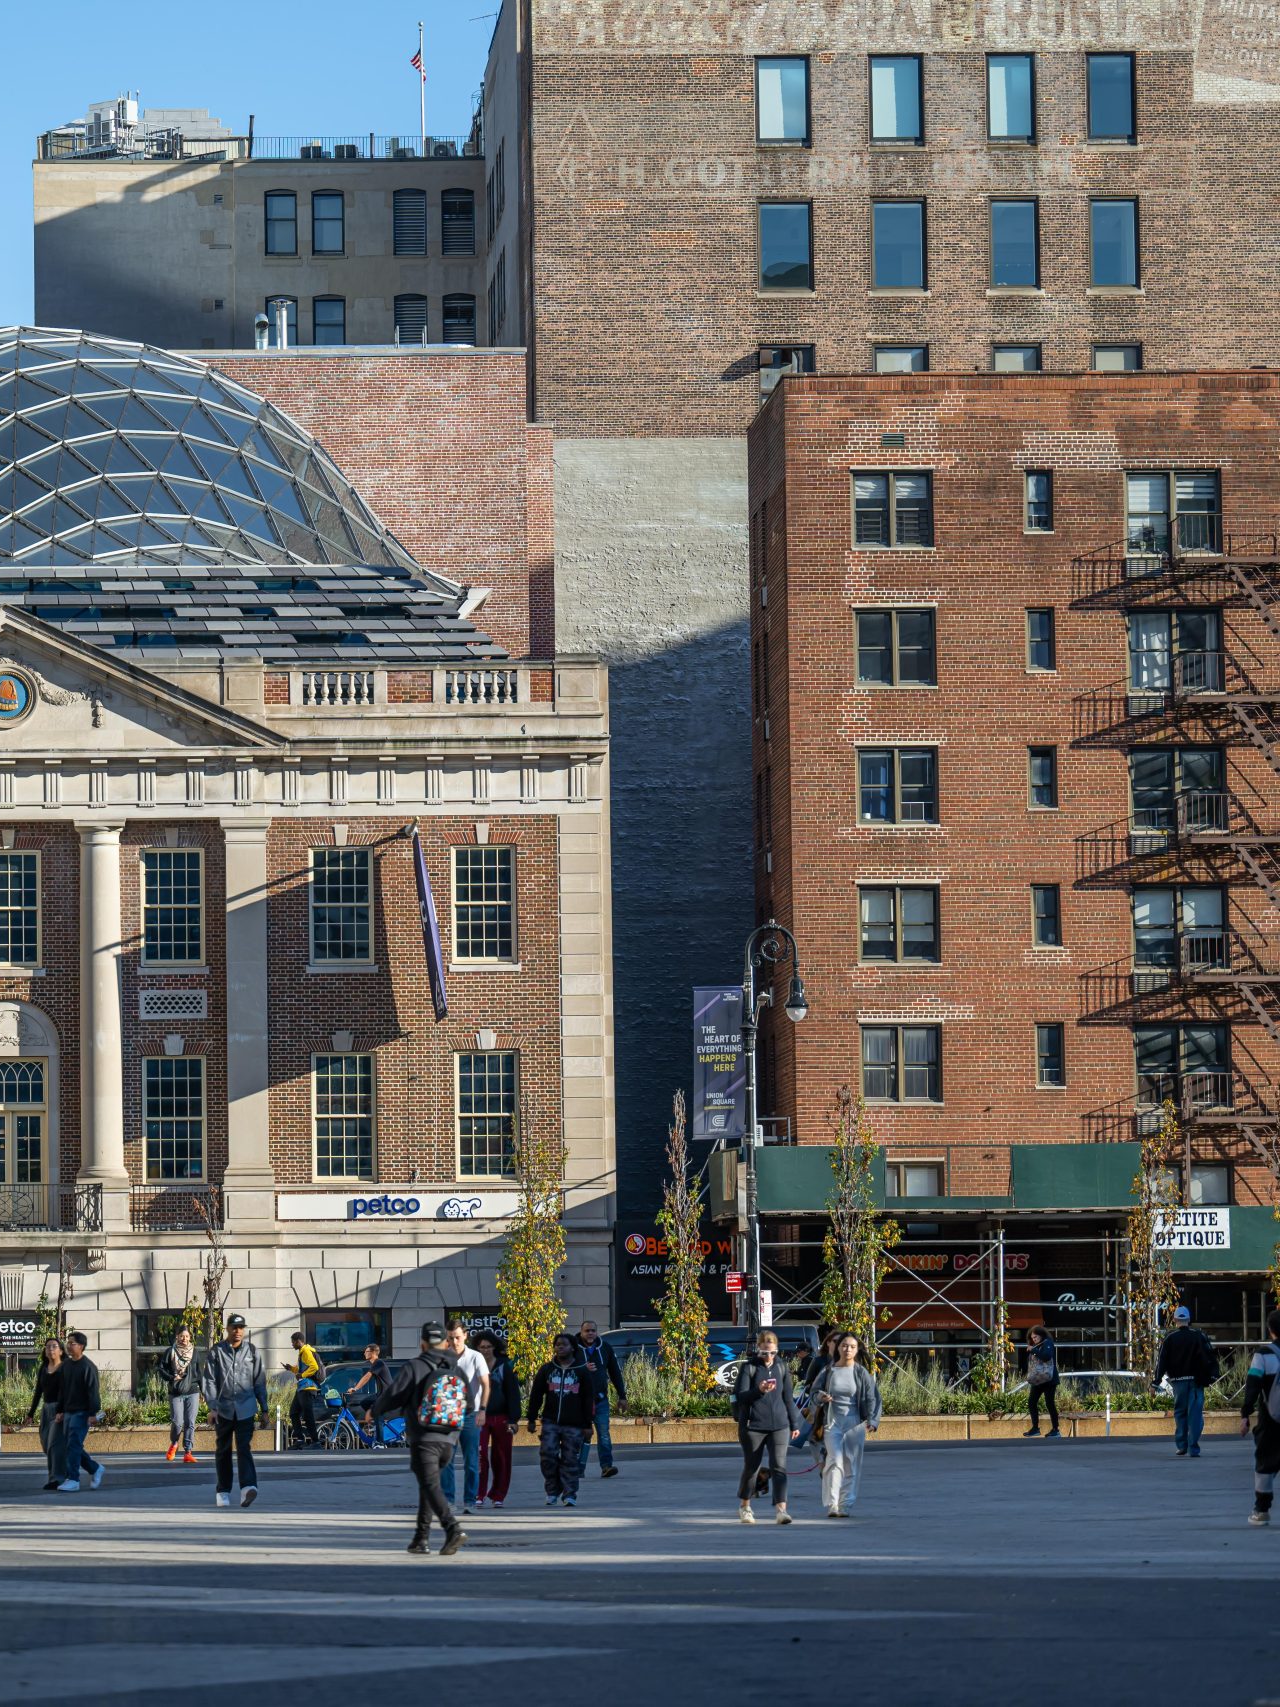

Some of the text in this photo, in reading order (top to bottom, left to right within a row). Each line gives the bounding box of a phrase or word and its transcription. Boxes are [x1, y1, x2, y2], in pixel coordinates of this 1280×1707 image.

[701, 1026, 716, 1034] THE
[705, 1034, 741, 1043] HEART OF
[697, 1044, 742, 1054] EVERYTHING
[699, 1054, 737, 1062] HAPPENS
[714, 1063, 735, 1072] HERE
[353, 1195, 420, 1219] petco
[1155, 1231, 1225, 1246] OPTIQUE
[631, 1264, 662, 1275] ASIAN
[708, 1264, 717, 1274] &
